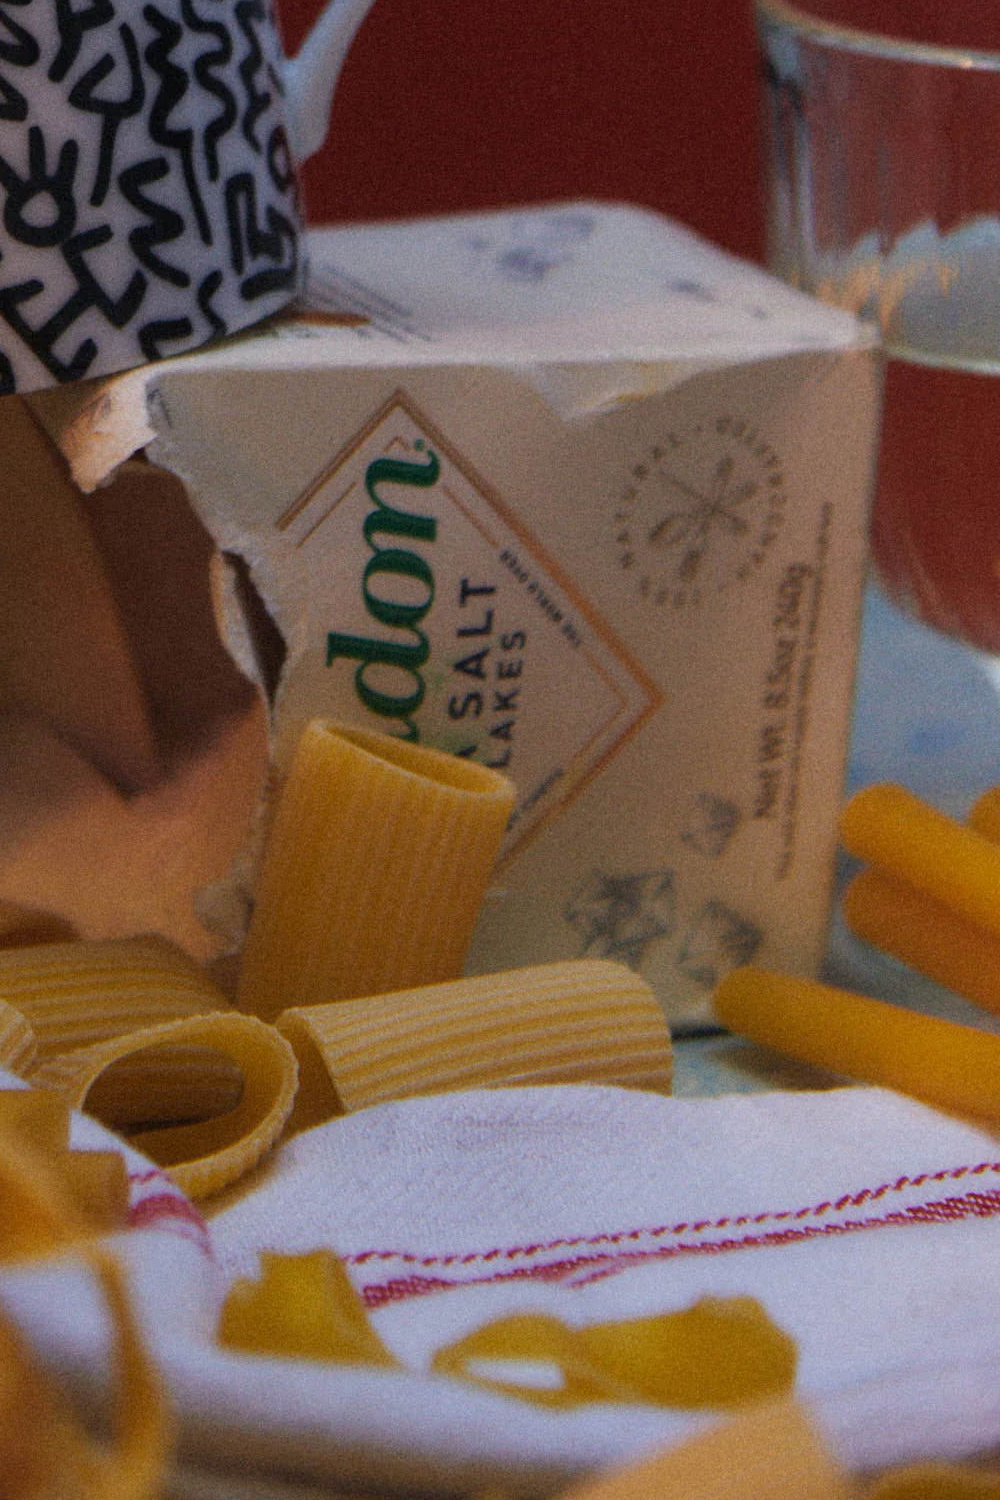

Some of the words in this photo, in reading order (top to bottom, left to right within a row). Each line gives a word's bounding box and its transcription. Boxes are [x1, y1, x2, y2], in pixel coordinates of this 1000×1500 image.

[499, 549, 529, 585] OVER
[447, 576, 497, 721] SALT
[484, 630, 527, 769] LAKES
